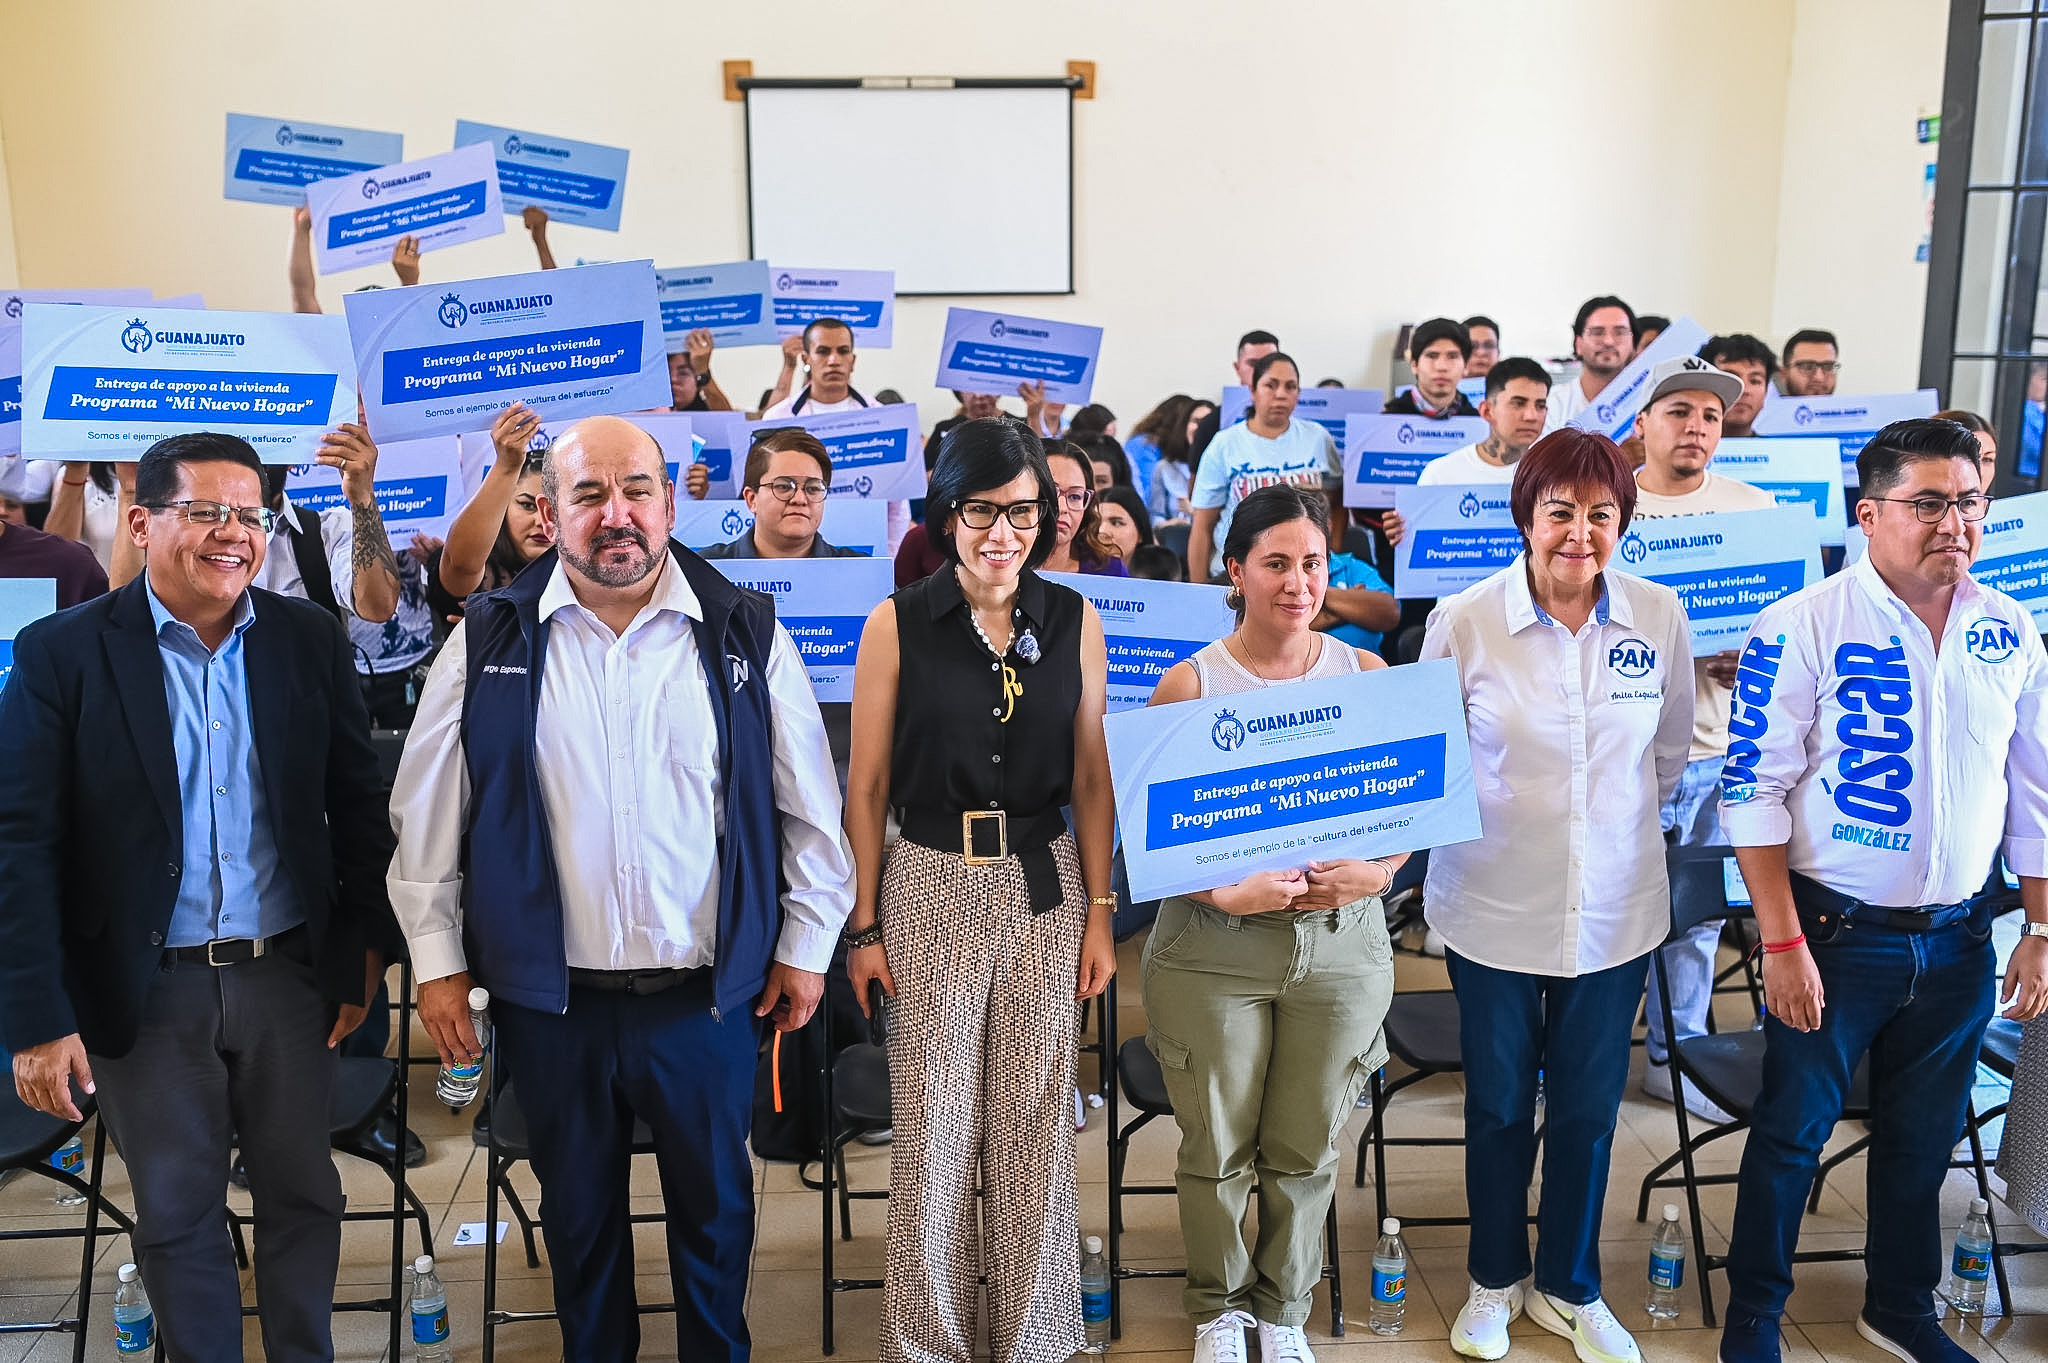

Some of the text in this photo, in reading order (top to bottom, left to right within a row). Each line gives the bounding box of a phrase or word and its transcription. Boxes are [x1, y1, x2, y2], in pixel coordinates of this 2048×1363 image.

[469, 294, 553, 315] GUANAJUATO
[155, 331, 245, 346] GUANAJUATO
[423, 337, 601, 368] Entrega de apoyo a la vivienda
[404, 349, 625, 389] Programa “Mi Nuevo Hogar”
[95, 377, 290, 394] Entrega de apoyo a la vivienda
[70, 393, 314, 416] Programa “Mi Nuevo Hogar”
[425, 408, 455, 418] Somos
[457, 406, 464, 414] el
[466, 402, 499, 413] ejemplo
[500, 400, 511, 408] de
[558, 392, 572, 400] del
[87, 431, 120, 440] Somos
[123, 432, 131, 440] el
[133, 432, 169, 442] ejemplo
[1983, 518, 2024, 534] AJUATO
[1648, 533, 1723, 551] GUANAJUATO
[1426, 549, 1482, 561] Programa
[1672, 583, 1697, 593] poyo
[1708, 579, 1719, 588] la
[1720, 574, 1767, 587] vivienda
[1088, 598, 1145, 613] ANAJUATO
[1692, 595, 1736, 609] Nuevo
[801, 641, 855, 657] Hogar”
[1966, 627, 2020, 653] PAN
[1109, 645, 1175, 659] a la vivienda
[1609, 648, 1656, 669] PAN
[810, 675, 840, 684] fuerzo”
[1247, 705, 1342, 734] GUANAJUATO
[1193, 756, 1399, 802] Entrega de apoyo a la vivienda
[1171, 769, 1426, 830] Programa “Mi Nuevo Hogar”
[1195, 852, 1230, 865] Somos
[1232, 849, 1240, 858] el
[1243, 842, 1281, 858] ejemplo
[1283, 838, 1295, 849] de
[1297, 837, 1306, 846] la
[1349, 825, 1365, 837] del
